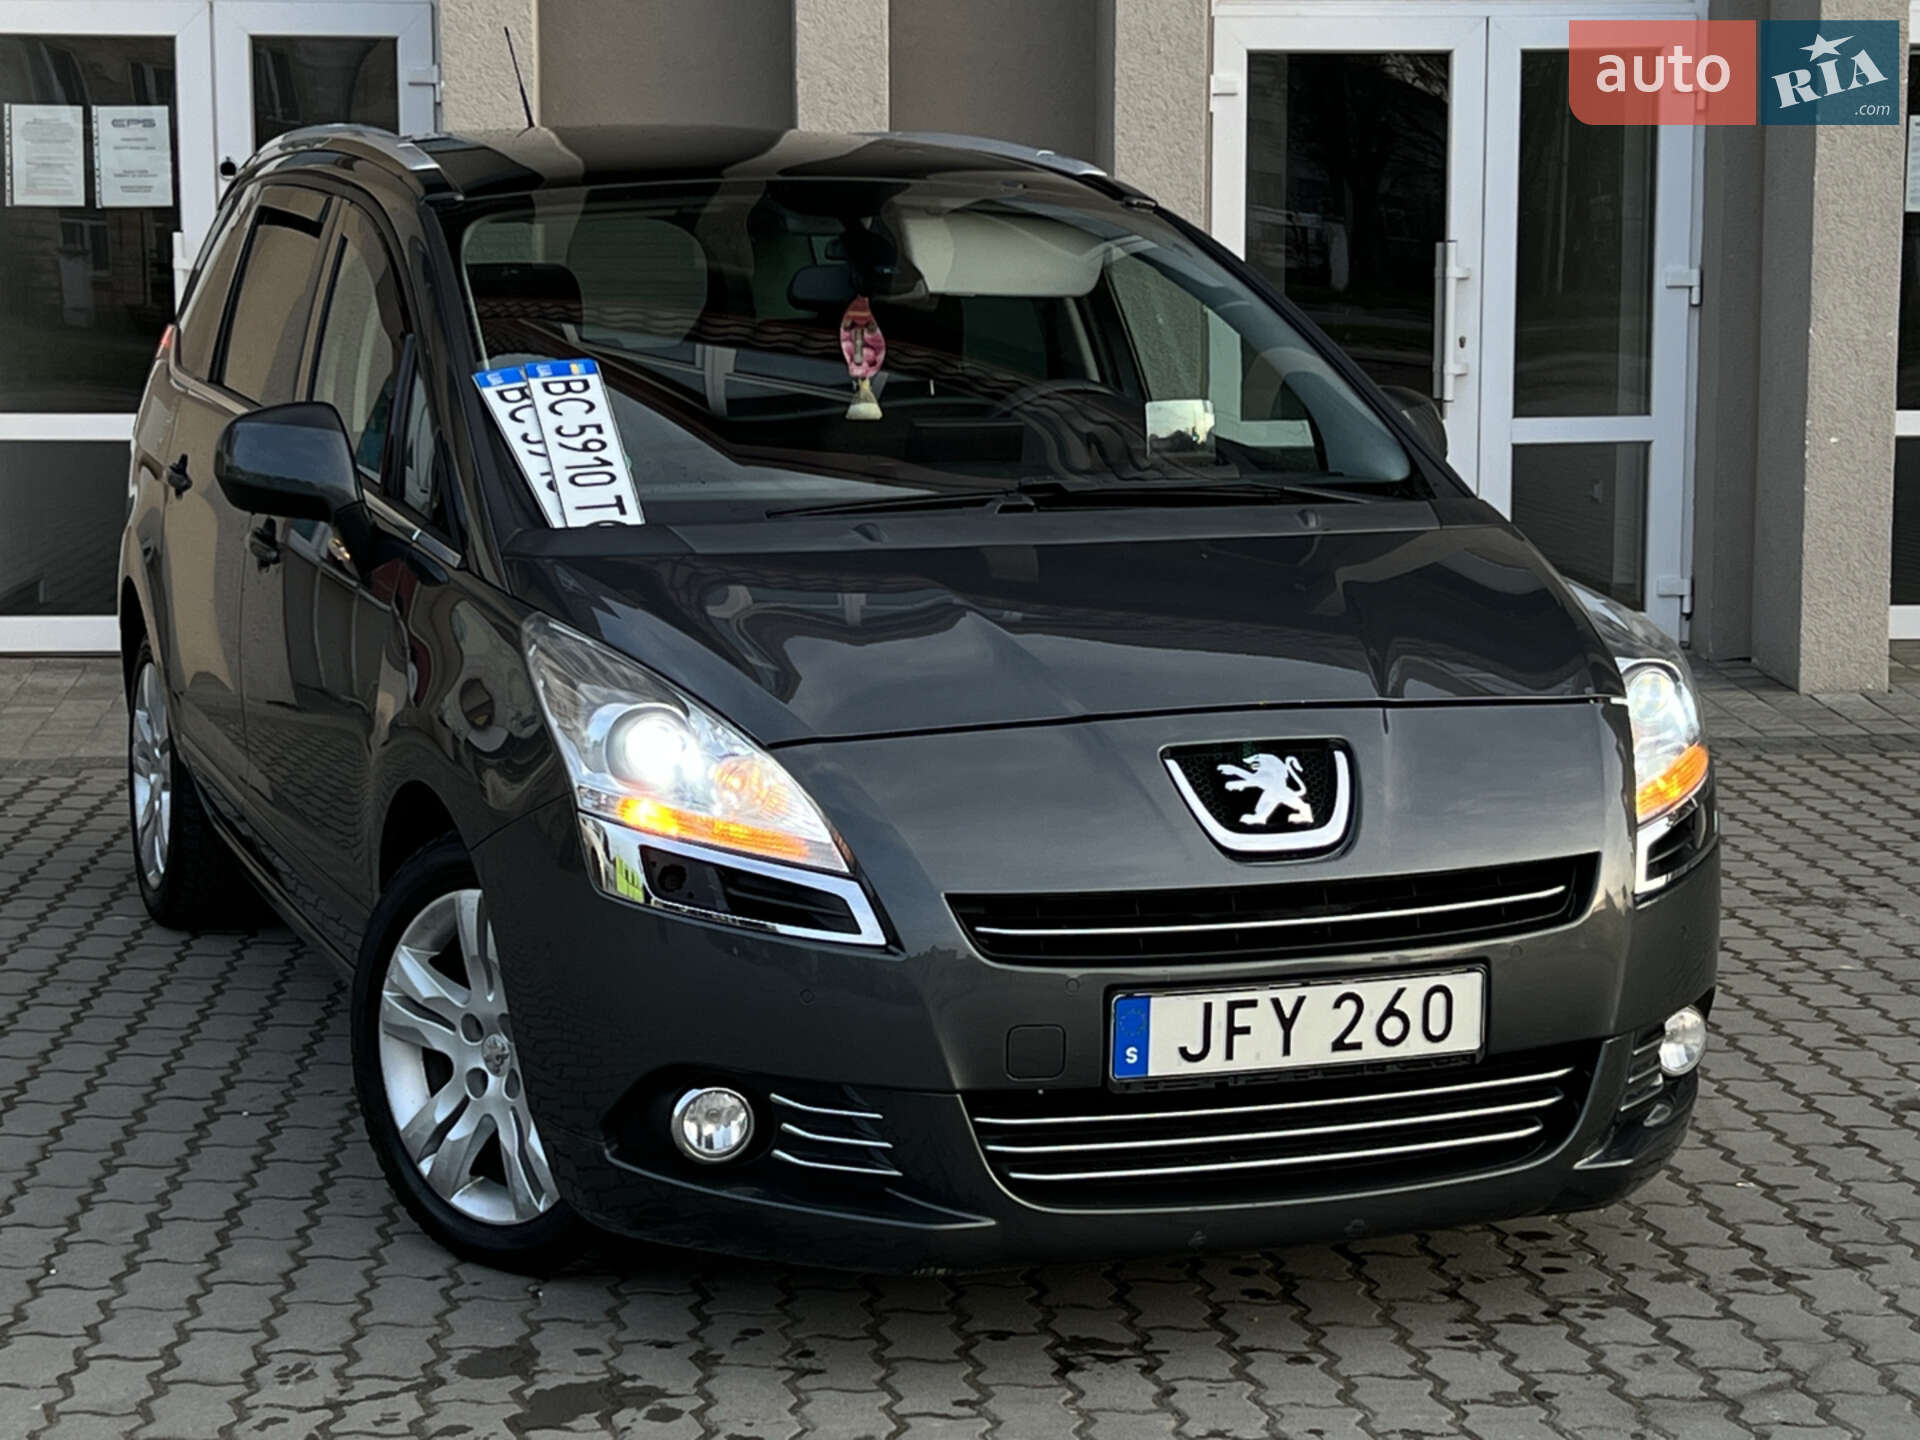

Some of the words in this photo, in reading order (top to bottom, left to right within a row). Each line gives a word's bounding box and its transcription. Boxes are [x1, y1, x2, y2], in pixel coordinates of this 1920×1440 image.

[541, 378, 596, 416] BC
[554, 423, 617, 487] 5910
[1178, 995, 1306, 1063] JFY
[1331, 984, 1453, 1052] 260
[1124, 1046, 1138, 1064] S
